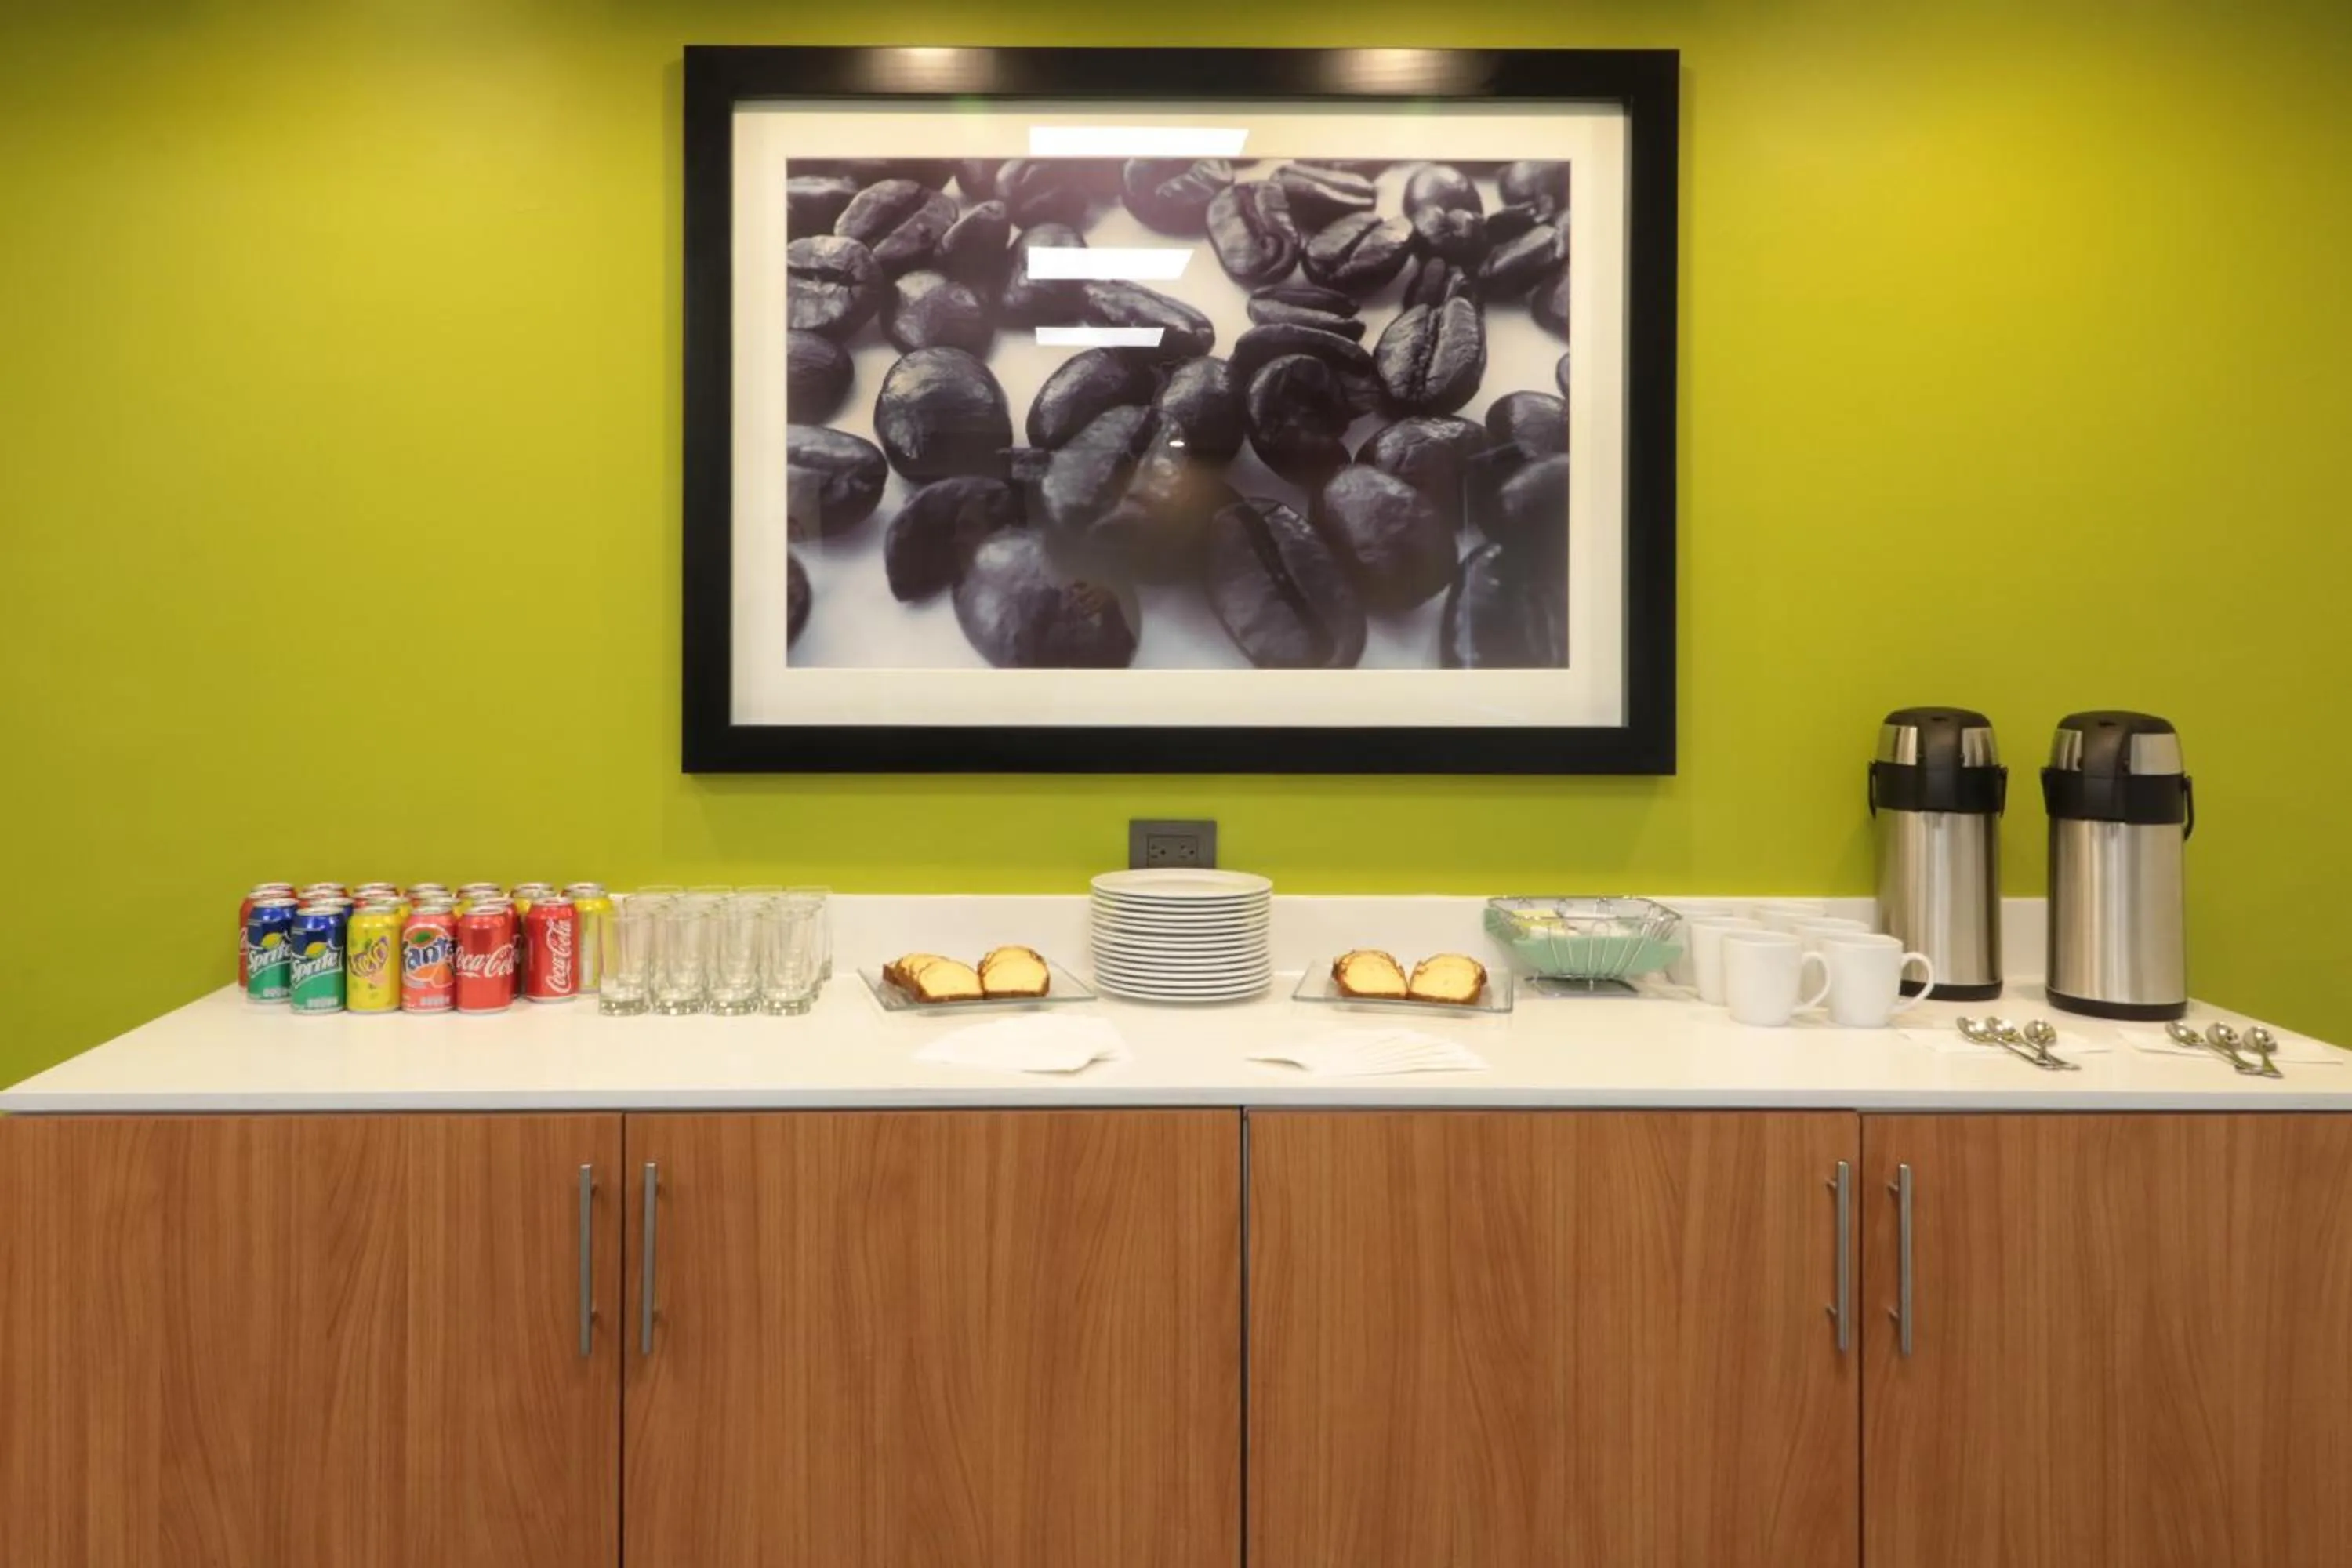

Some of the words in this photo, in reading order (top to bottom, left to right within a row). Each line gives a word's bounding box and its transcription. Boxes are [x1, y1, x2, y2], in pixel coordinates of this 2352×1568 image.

[292, 948, 338, 984] Sprite
[456, 943, 514, 978] Coca-Col
[546, 918, 571, 993] Coca-Cola
